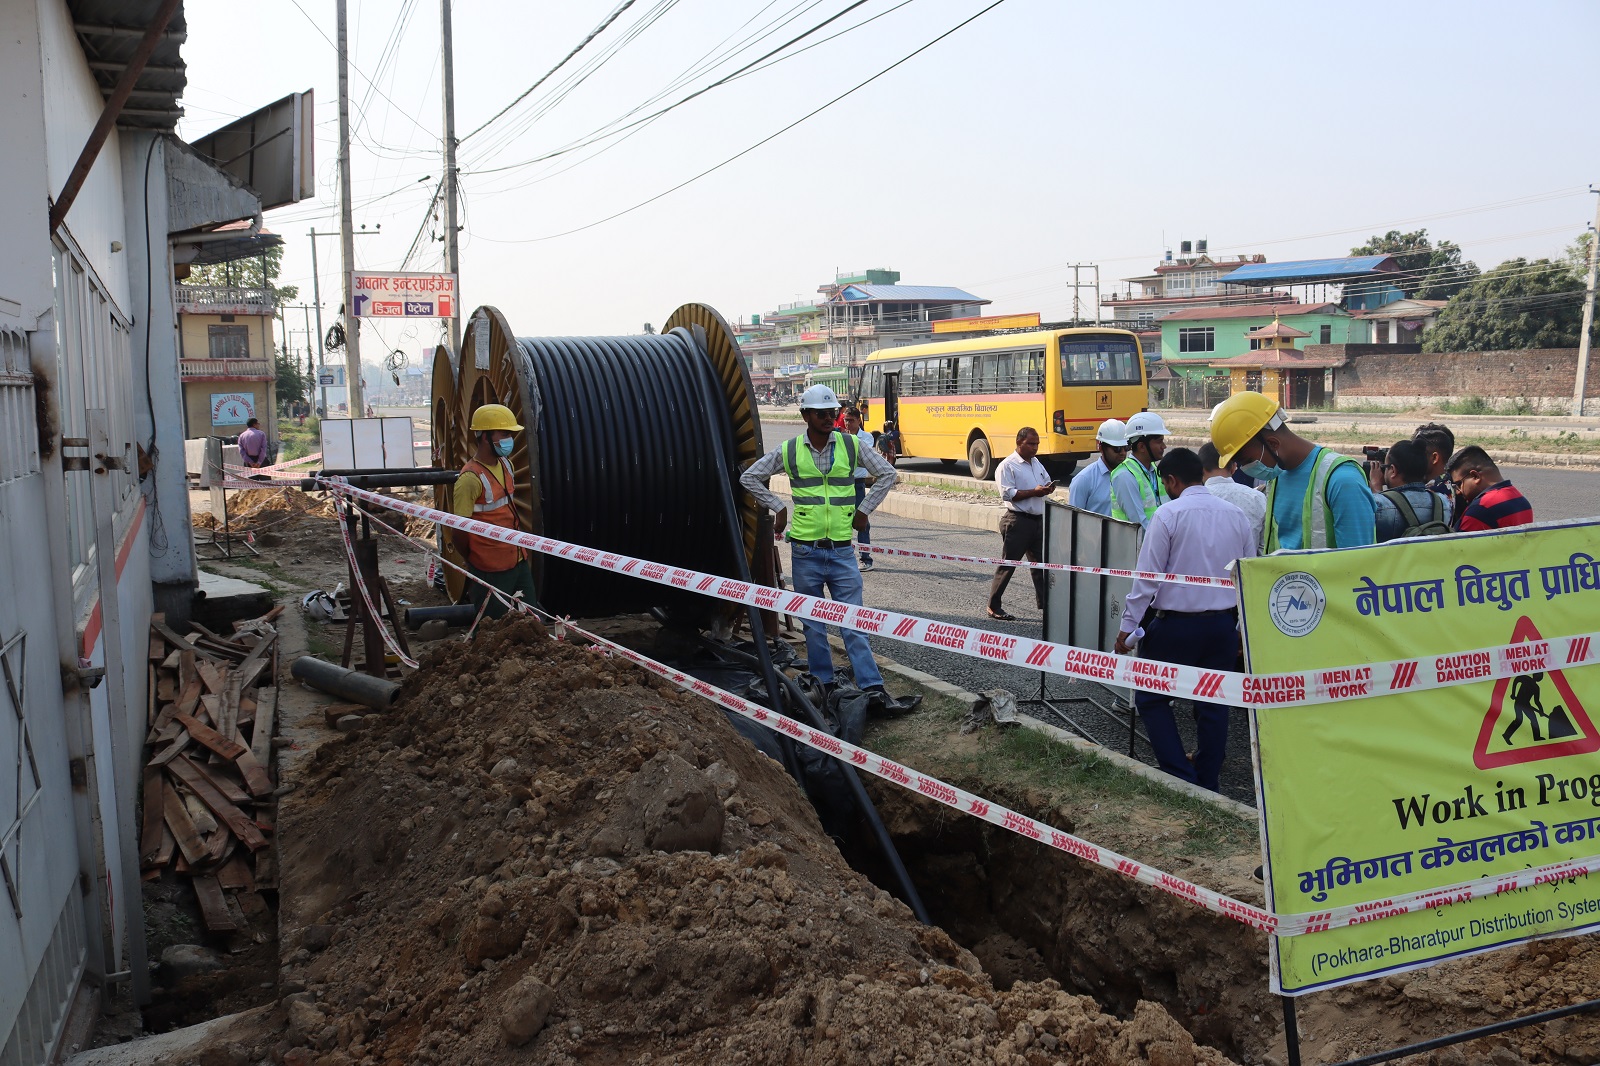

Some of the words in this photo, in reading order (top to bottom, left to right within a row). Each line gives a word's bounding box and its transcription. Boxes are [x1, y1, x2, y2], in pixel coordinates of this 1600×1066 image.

[355, 276, 390, 290] अवतार
[374, 302, 400, 314] डिजल
[407, 302, 431, 314] पेट्रोल
[1104, 344, 1132, 352] SCHOOL
[1098, 361, 1105, 370] 8
[518, 538, 536, 547] DANGER
[540, 544, 555, 552] WORK
[574, 553, 595, 562] DANGER
[578, 548, 600, 557] CAUTION
[600, 560, 616, 569] WORK
[643, 563, 669, 573] CAUTION
[640, 569, 664, 580] DANGER
[672, 569, 686, 577] MEN
[1109, 569, 1132, 577] DANGER
[1185, 576, 1211, 584] DANGER
[670, 577, 688, 587] WORK
[721, 580, 751, 593] CAUTION
[717, 587, 746, 600] DANGER
[756, 588, 772, 596] MEN
[771, 591, 782, 599] AT
[1352, 576, 1444, 617] नेपाल
[1455, 565, 1530, 611] विद्युत
[754, 597, 774, 608] WORK
[814, 600, 849, 614] CAUTION
[810, 608, 845, 623] DANGER
[856, 609, 875, 619] MEN
[875, 612, 888, 622] AT
[1281, 624, 1306, 635] ELECTRICITY
[1306, 608, 1321, 631] AUTHORITY
[856, 619, 879, 632] WORK
[927, 623, 969, 639] CAUTION
[924, 633, 965, 649] DANGER
[979, 633, 1001, 645] MEN
[1002, 637, 1017, 648] AT
[980, 646, 1008, 660] WORK
[1067, 649, 1118, 669] CAUTION
[1505, 645, 1531, 660] MEN
[1534, 643, 1549, 656] AT
[1435, 652, 1491, 671] CAUTION
[1511, 658, 1547, 673] WORK
[1064, 661, 1114, 680] DANGER
[1132, 661, 1158, 676] MEN
[1161, 666, 1178, 679] AT
[1323, 671, 1351, 684] MEN
[1354, 667, 1371, 681] AT
[1437, 665, 1492, 683] DANGER
[1134, 676, 1170, 692] WORK
[1242, 675, 1305, 691] CAUTION
[1328, 683, 1367, 698] WORK
[1242, 689, 1305, 704] DANGER
[809, 735, 842, 755] CAUTION
[889, 771, 911, 784] MEN
[917, 783, 958, 805] CAUTION
[1392, 784, 1488, 830] Work
[1495, 780, 1527, 813] in
[1535, 773, 1600, 807] Prog
[1298, 851, 1414, 903] भुमिगत
[1418, 820, 1548, 870] केबलको
[1534, 866, 1589, 886] CAUTION
[1161, 874, 1197, 896] WORK
[1349, 906, 1408, 926] CAUTION
[1311, 926, 1465, 976] (Pokhara-Bharatpur
[1470, 907, 1556, 937] Distribution
